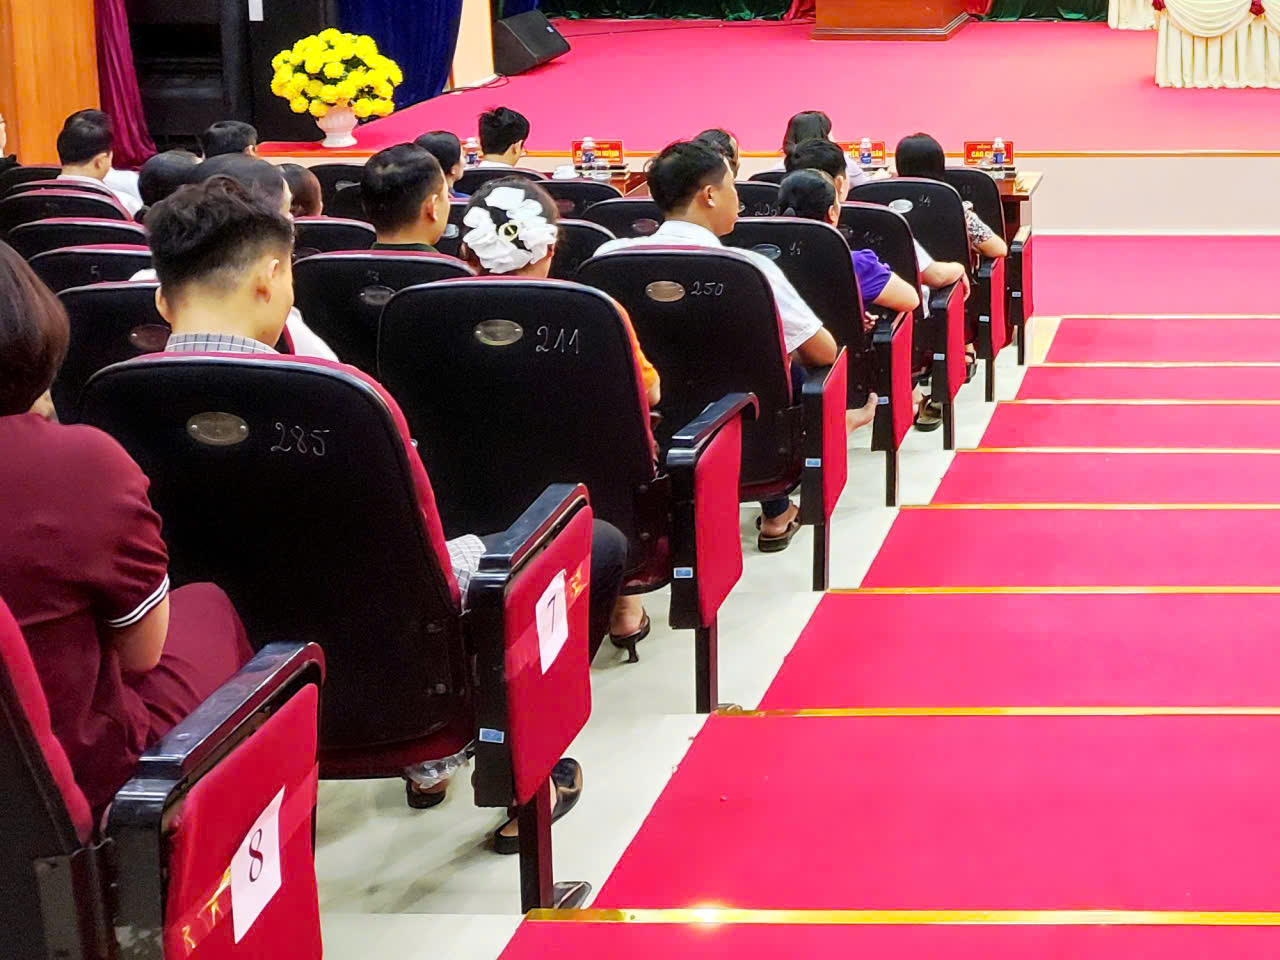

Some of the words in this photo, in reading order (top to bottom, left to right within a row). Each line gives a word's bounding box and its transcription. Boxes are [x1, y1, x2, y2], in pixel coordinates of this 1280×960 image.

[690, 280, 724, 296] 250
[535, 325, 579, 354] 211
[270, 422, 330, 456] 285
[248, 828, 264, 882] 8
